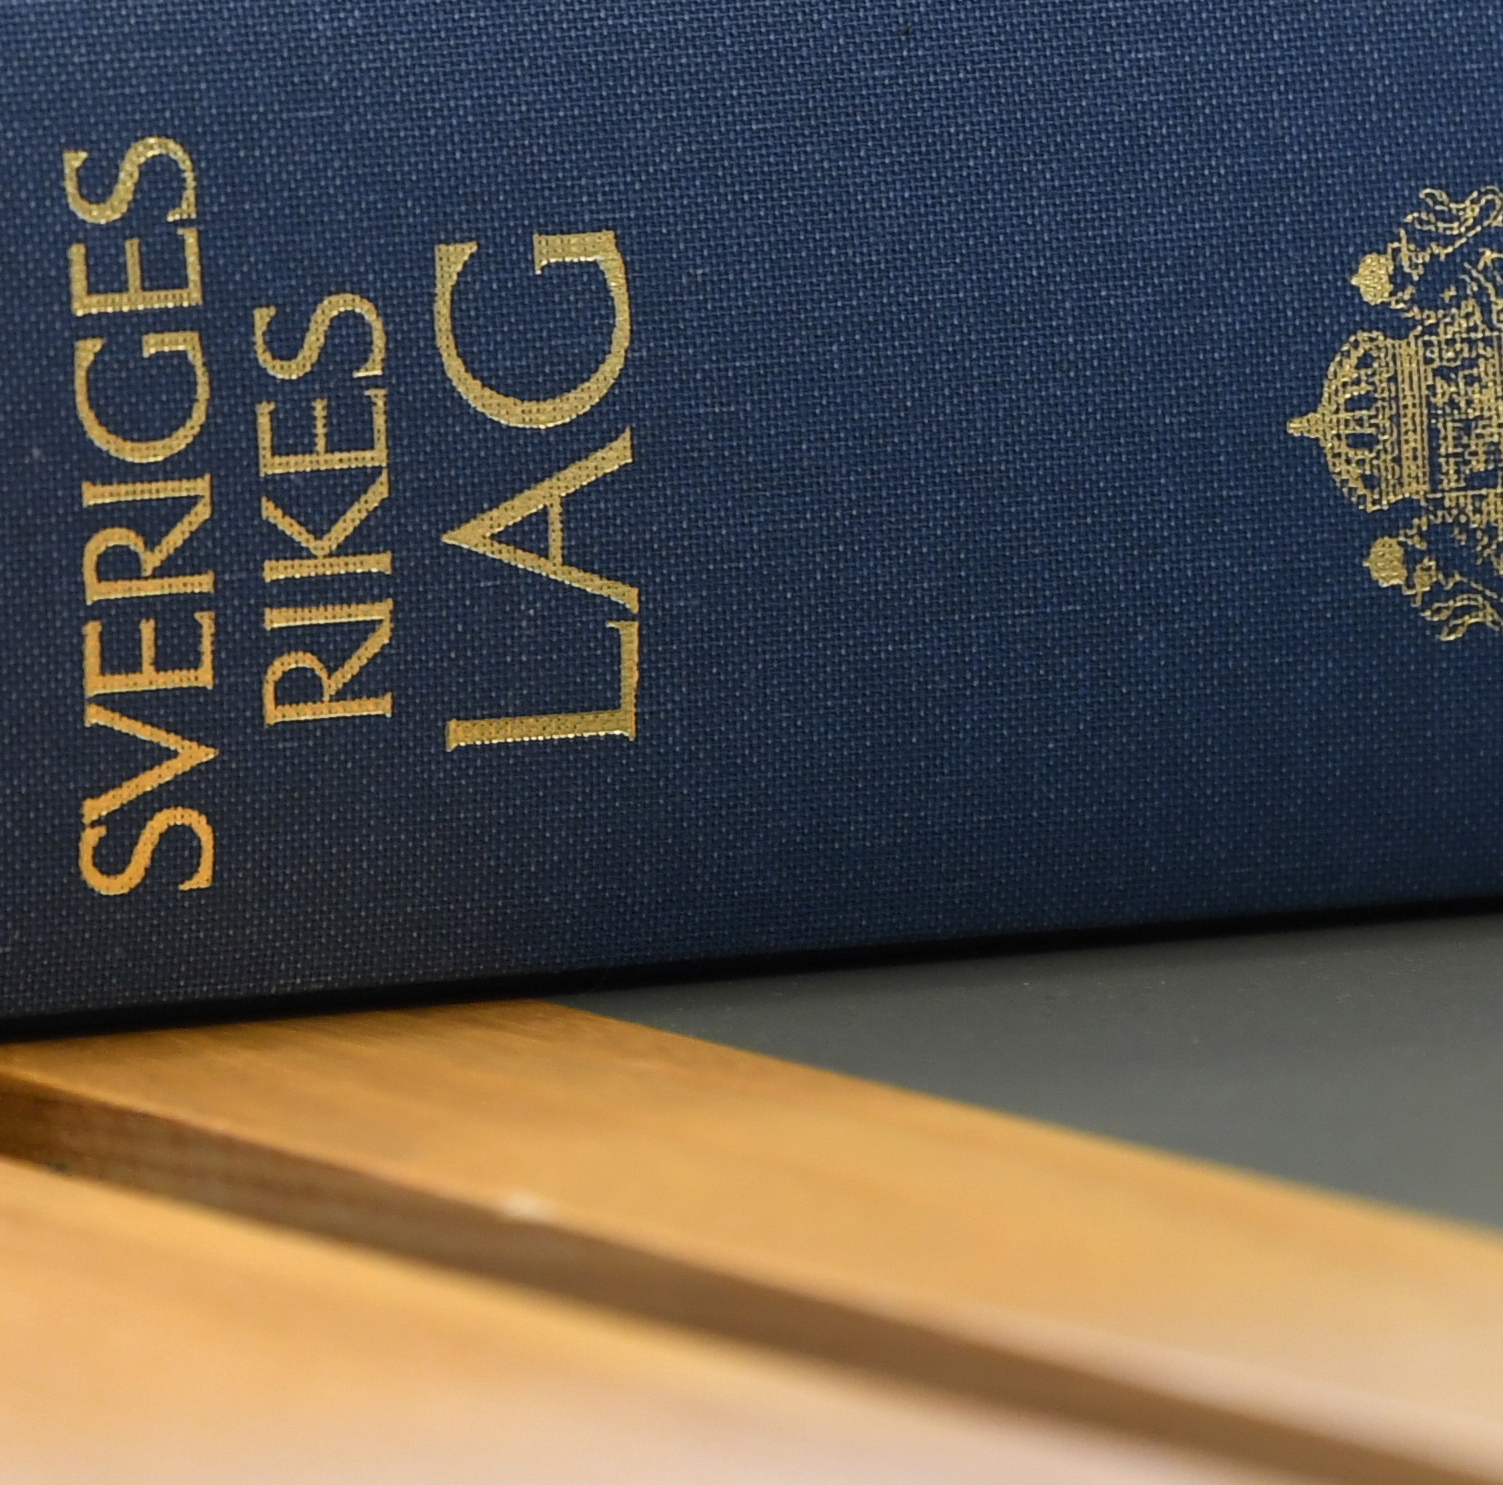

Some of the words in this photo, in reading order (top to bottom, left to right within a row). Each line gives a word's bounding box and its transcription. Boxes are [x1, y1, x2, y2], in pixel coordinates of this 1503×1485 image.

[62, 135, 220, 896] SVERIGES
[253, 291, 393, 726] RIKES
[434, 229, 640, 752] LAG
